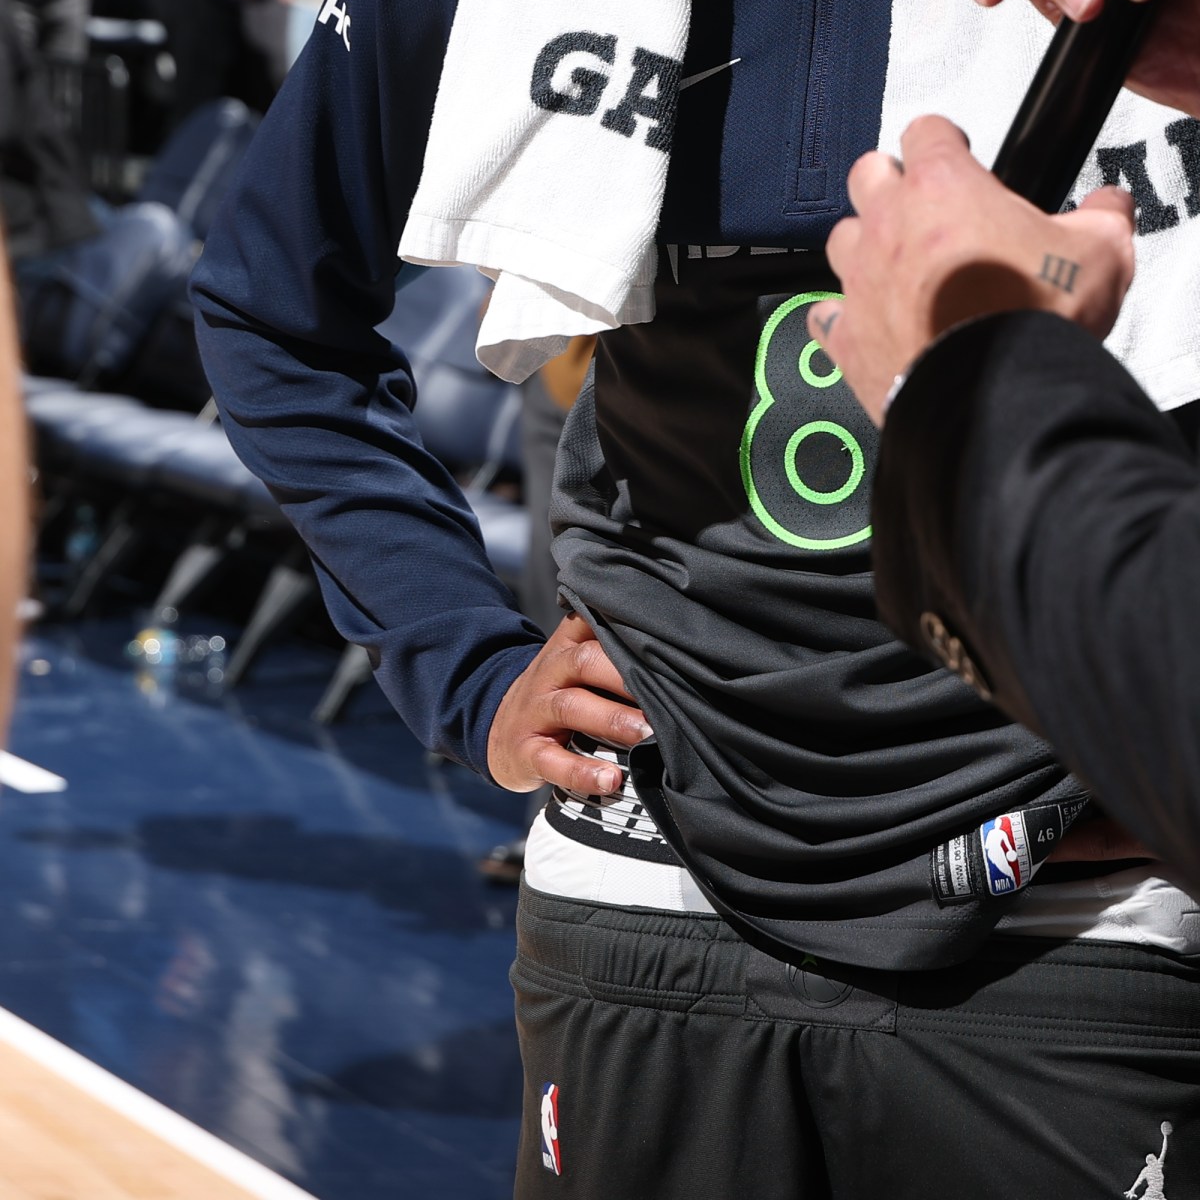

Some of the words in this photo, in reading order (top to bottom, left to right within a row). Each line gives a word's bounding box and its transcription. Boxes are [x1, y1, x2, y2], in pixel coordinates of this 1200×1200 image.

[739, 291, 873, 550] 8
[1037, 827, 1055, 843] 46
[995, 878, 1011, 892] NBA
